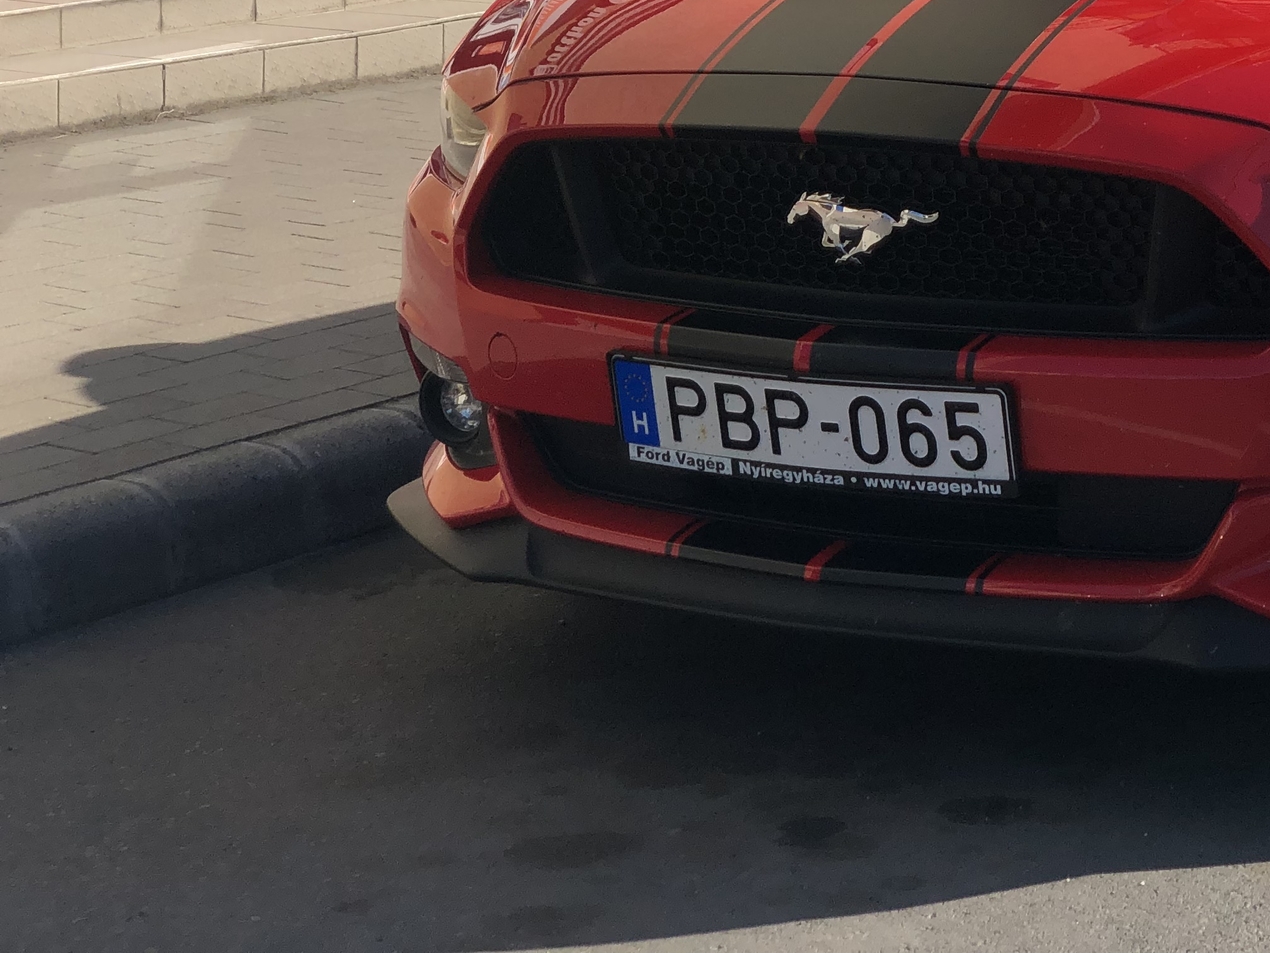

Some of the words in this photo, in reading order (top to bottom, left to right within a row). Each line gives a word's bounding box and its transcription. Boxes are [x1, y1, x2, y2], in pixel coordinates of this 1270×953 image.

[631, 410, 649, 435] H
[665, 375, 988, 471] PBP-065
[636, 447, 671, 463] Ford
[675, 452, 725, 473] Vagép
[738, 461, 844, 485] Nyíregyháza
[864, 476, 1002, 496] www.vagep.hu
